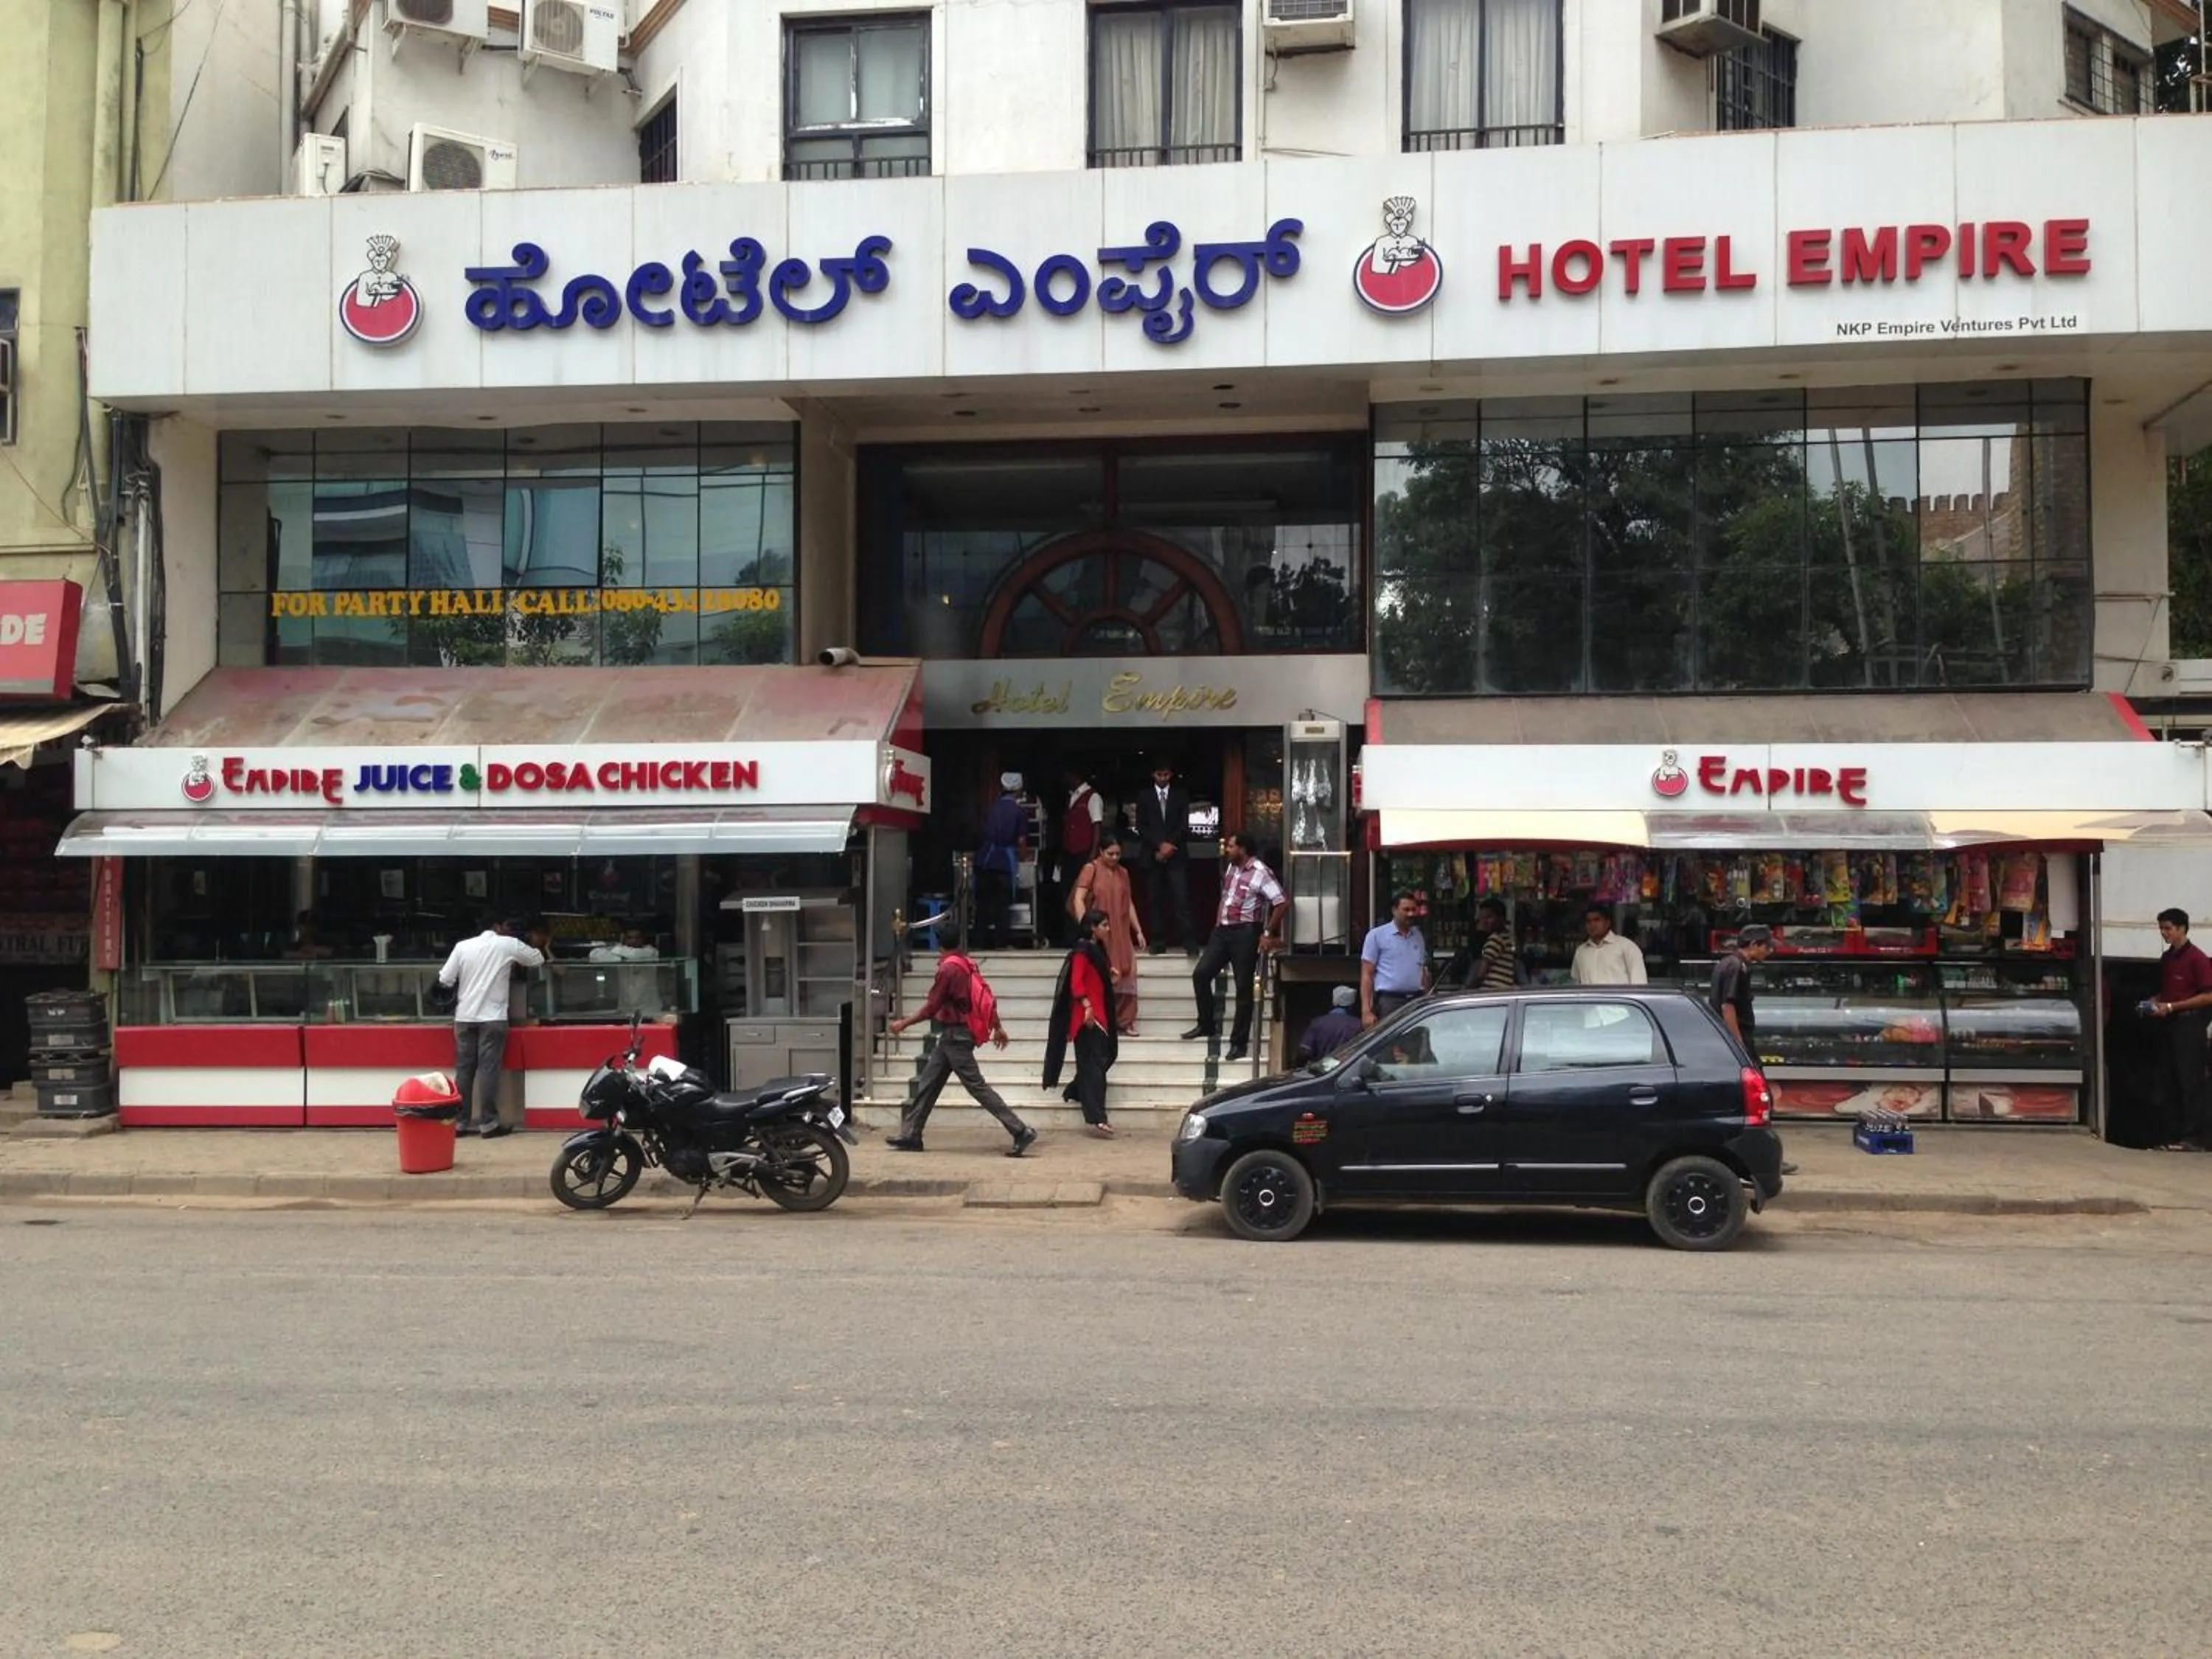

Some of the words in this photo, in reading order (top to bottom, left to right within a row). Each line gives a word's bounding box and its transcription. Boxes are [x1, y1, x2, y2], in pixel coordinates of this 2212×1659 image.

[465, 235, 892, 331] ಹೋಟೆಲ್
[950, 218, 1304, 344] ಎಂಪೈರ್
[1498, 235, 1757, 301] HOTEL
[1787, 218, 2092, 286] EMPIRE
[1836, 322, 1872, 336] NKP
[1877, 322, 1935, 337] Empire
[1940, 319, 2013, 333] Ventures
[2018, 316, 2046, 330] Pvt
[2051, 315, 2077, 329] Ltd
[271, 591, 327, 616] FOR
[334, 591, 426, 616] PARTY
[429, 589, 504, 616] HALL
[970, 677, 1075, 715] Hotel
[1101, 671, 1239, 723] Empire
[221, 757, 344, 805] EMPIRE
[353, 764, 453, 793] JUICE
[459, 762, 482, 792] &
[487, 762, 594, 792] DOSA
[597, 760, 759, 791] CHICKEN
[1697, 755, 1868, 807] EMPIRE
